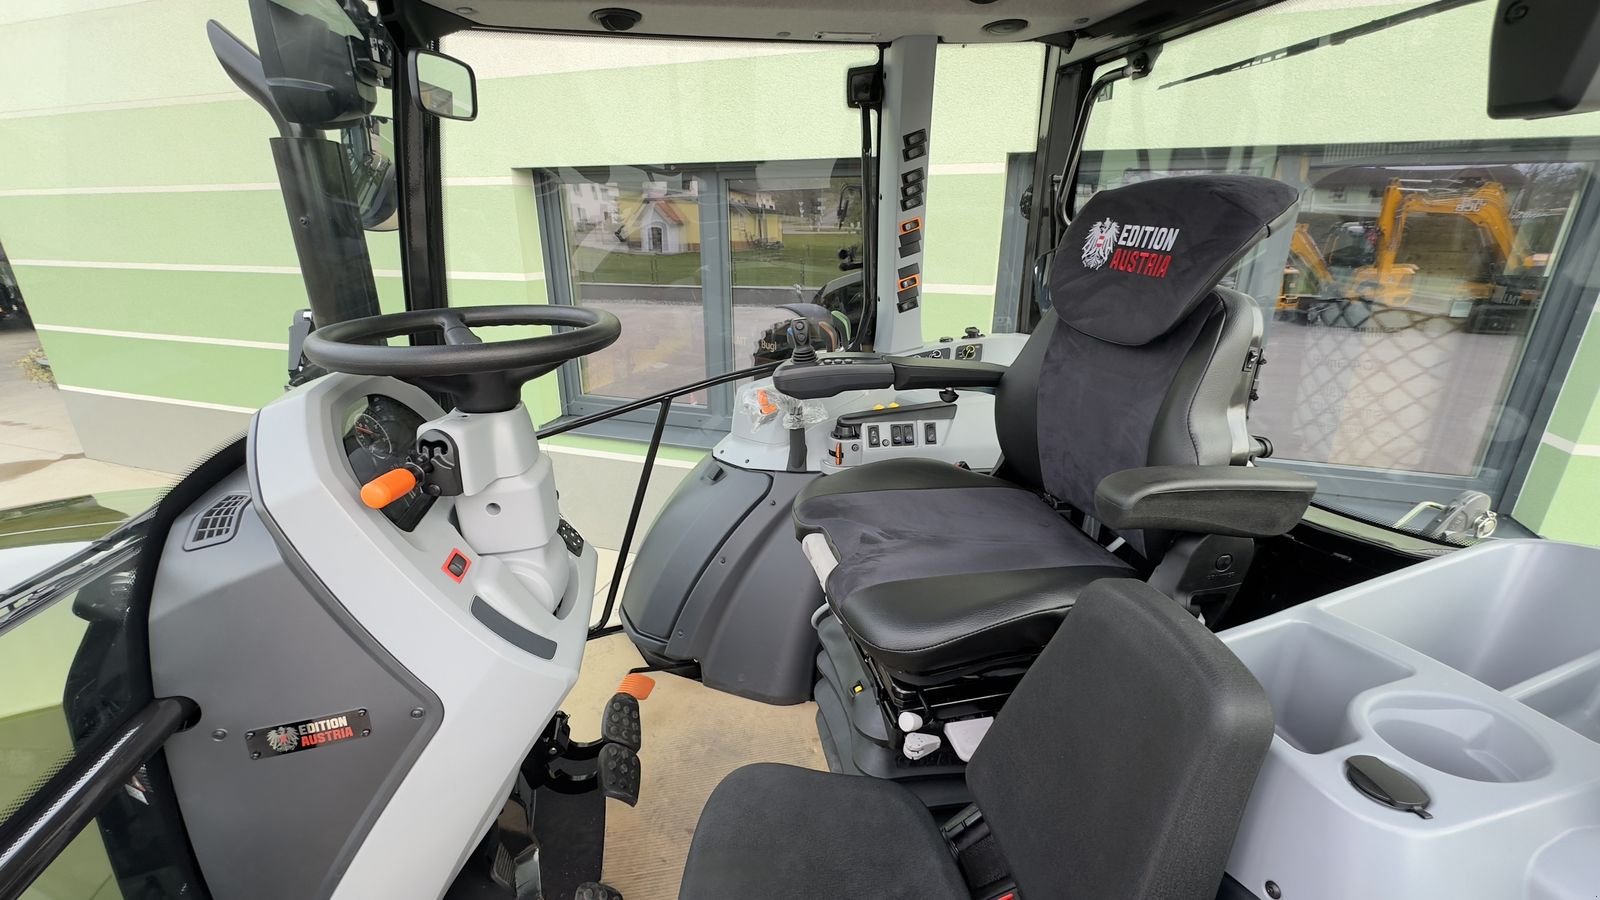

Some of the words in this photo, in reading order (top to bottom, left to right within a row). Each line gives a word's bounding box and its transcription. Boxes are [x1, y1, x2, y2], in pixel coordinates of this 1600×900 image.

[1117, 224, 1180, 252] EDITION
[1109, 247, 1172, 278] AUSTRIA
[298, 715, 348, 736] EDITION
[301, 726, 353, 747] AUSTRIA
